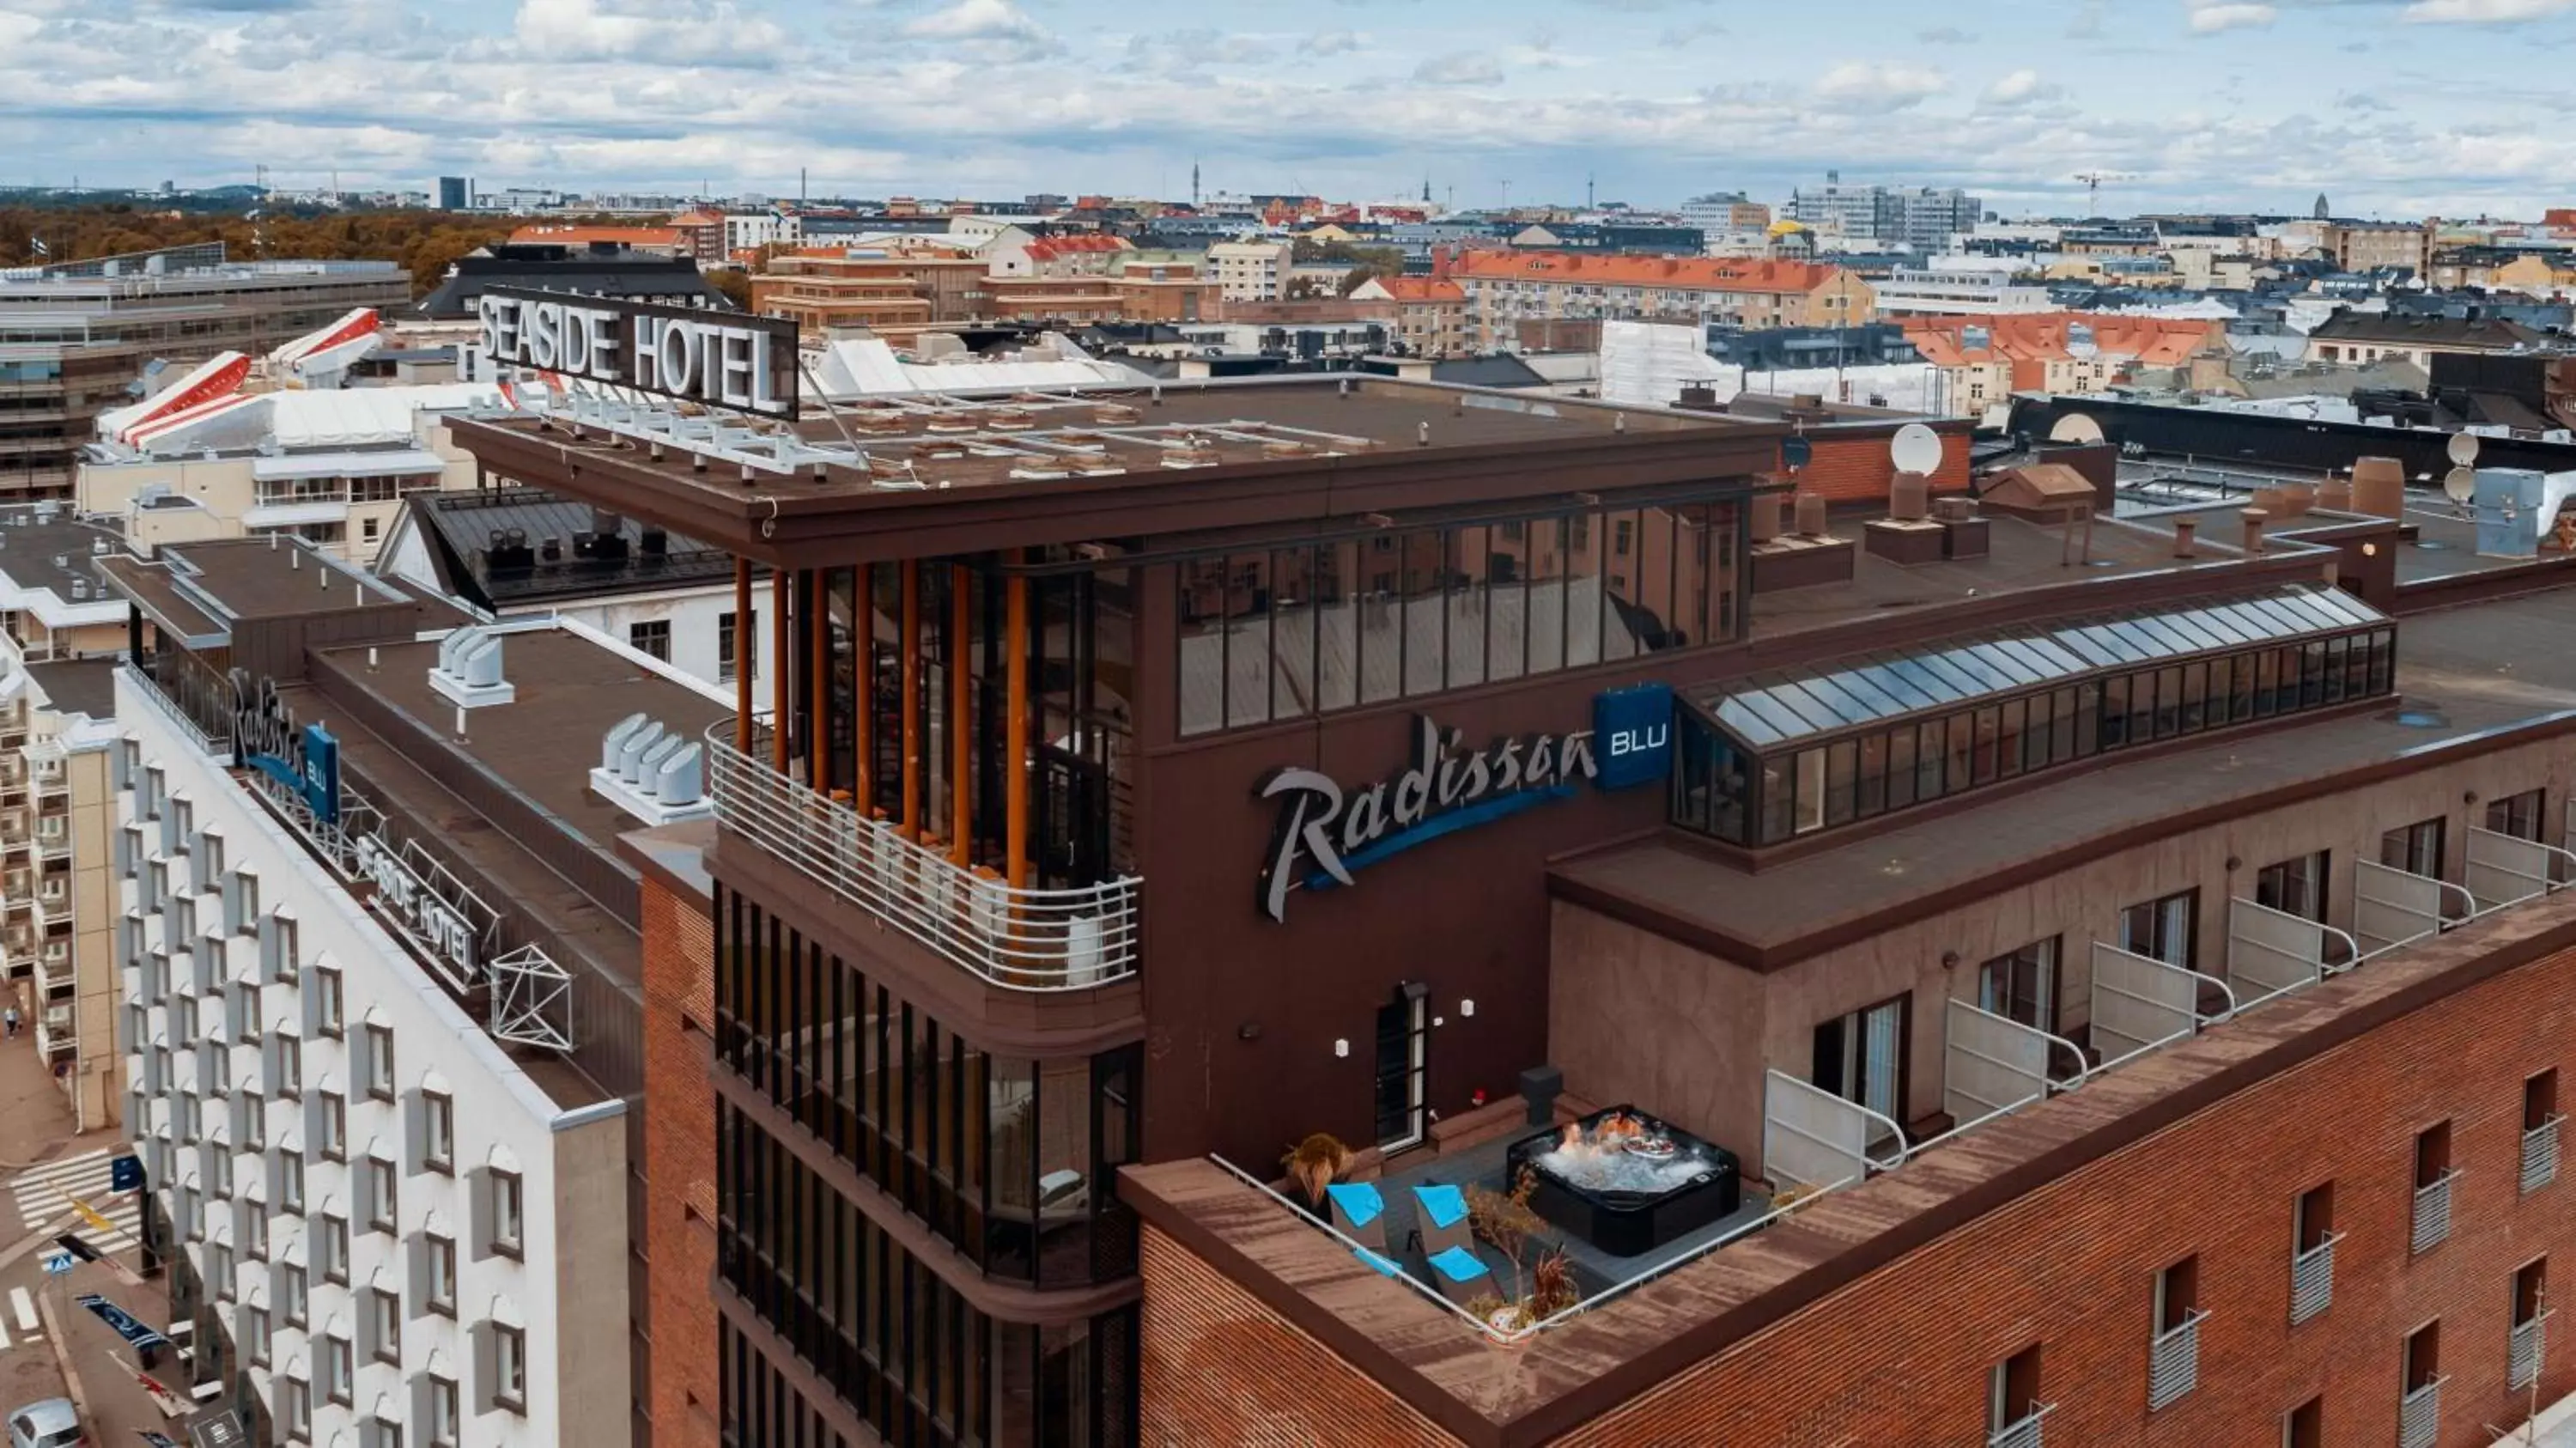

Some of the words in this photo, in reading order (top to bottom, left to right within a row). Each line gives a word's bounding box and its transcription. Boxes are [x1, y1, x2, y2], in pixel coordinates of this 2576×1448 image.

[478, 295, 621, 381] SEASIDE
[634, 314, 789, 413] HOTEL
[307, 760, 327, 792] BLU
[1610, 723, 1668, 757] BLU
[1261, 715, 1596, 924] Radisson
[420, 894, 477, 976] HOTEL
